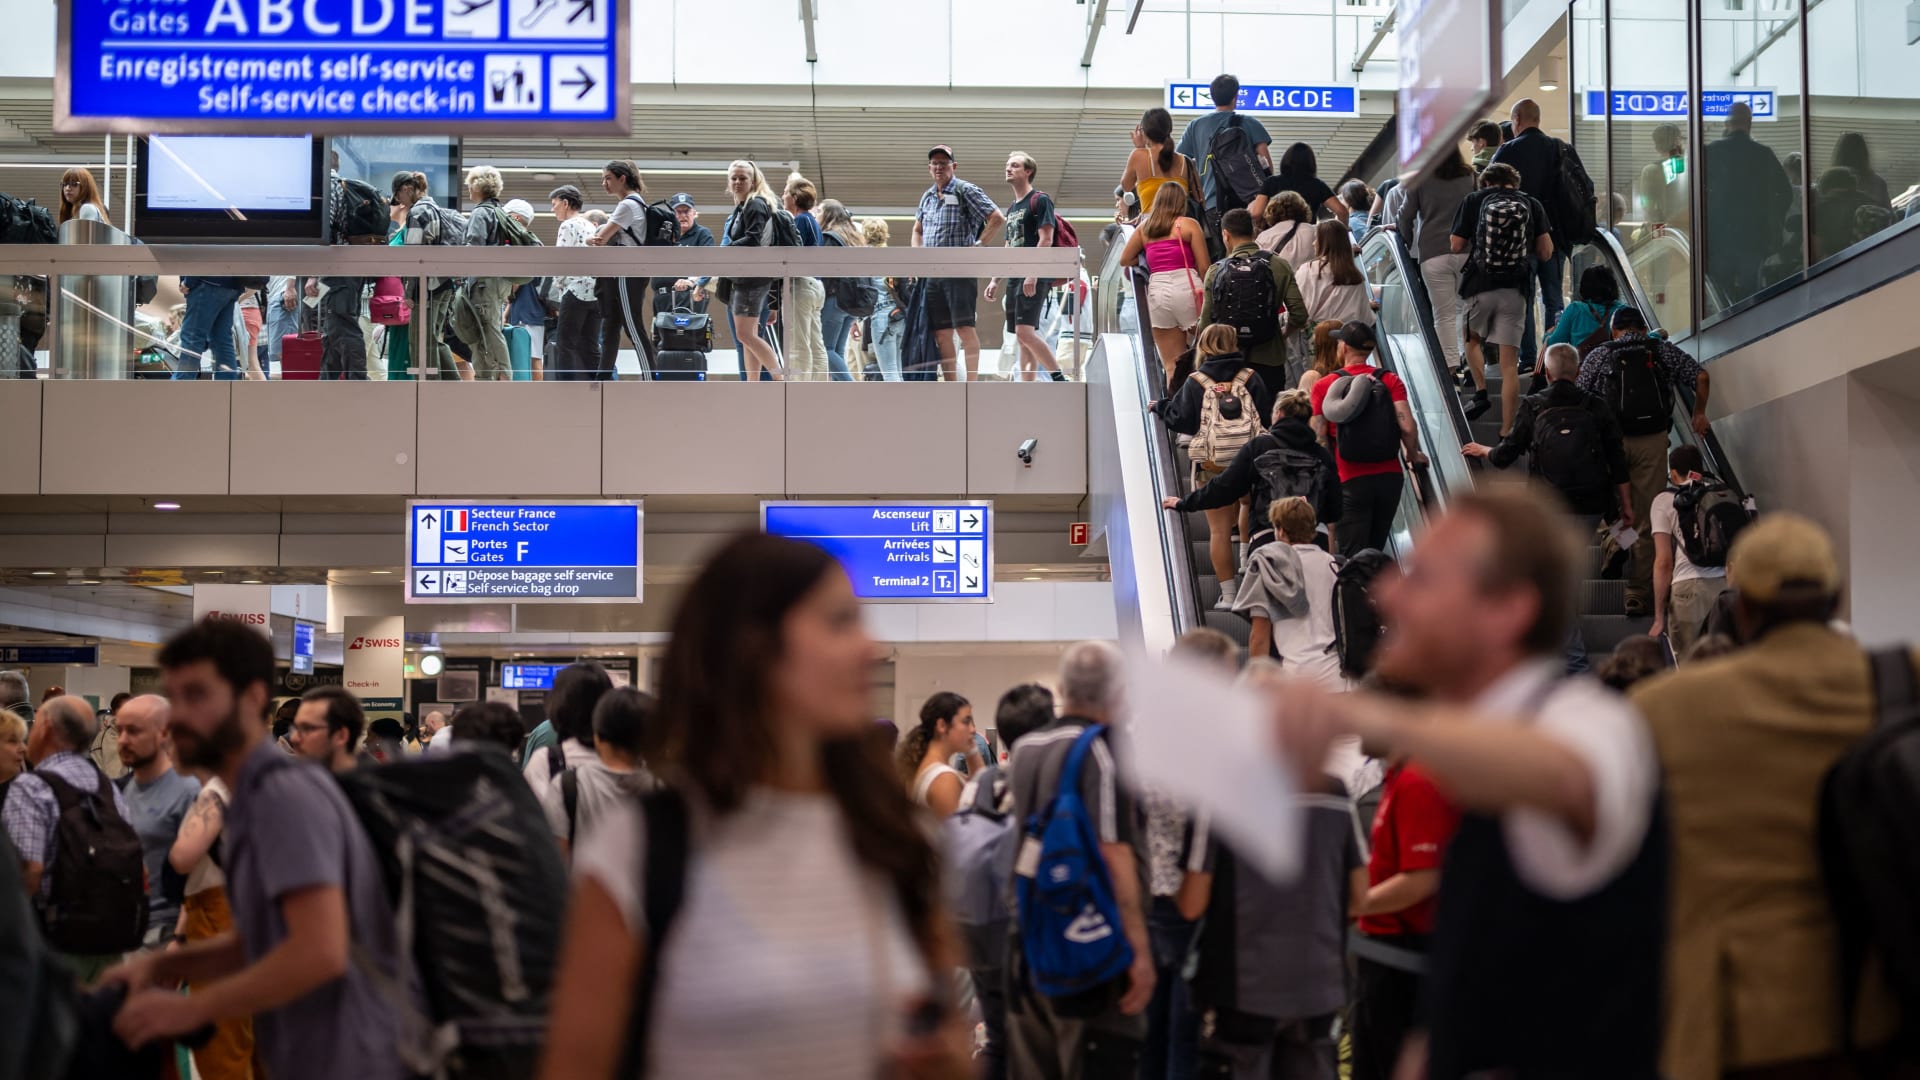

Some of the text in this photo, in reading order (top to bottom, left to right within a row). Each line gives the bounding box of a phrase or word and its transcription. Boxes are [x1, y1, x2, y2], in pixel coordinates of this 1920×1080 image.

[109, 9, 190, 33] Gates
[204, 0, 434, 35] ABCDE
[101, 53, 475, 87] Enregistrement self-service
[198, 84, 476, 113] Self-service check-in
[1255, 89, 1333, 108] ABCDE
[471, 509, 556, 519] Secteur France
[872, 509, 931, 519] Ascenseur
[471, 521, 550, 532] French Sector
[911, 521, 931, 532] Lift
[1074, 527, 1084, 542] F
[471, 539, 508, 549] Portes
[883, 539, 931, 550] Arrivées
[516, 541, 529, 562] F
[886, 551, 931, 562] Arrivals
[471, 553, 504, 562] Gates
[468, 570, 614, 583] Dépose bagage self service
[872, 576, 930, 586] Terminal 2
[468, 583, 580, 596] Self service bag drop
[364, 639, 400, 648] SWISS
[346, 680, 380, 688] Check-in
[371, 701, 396, 709] Economy
